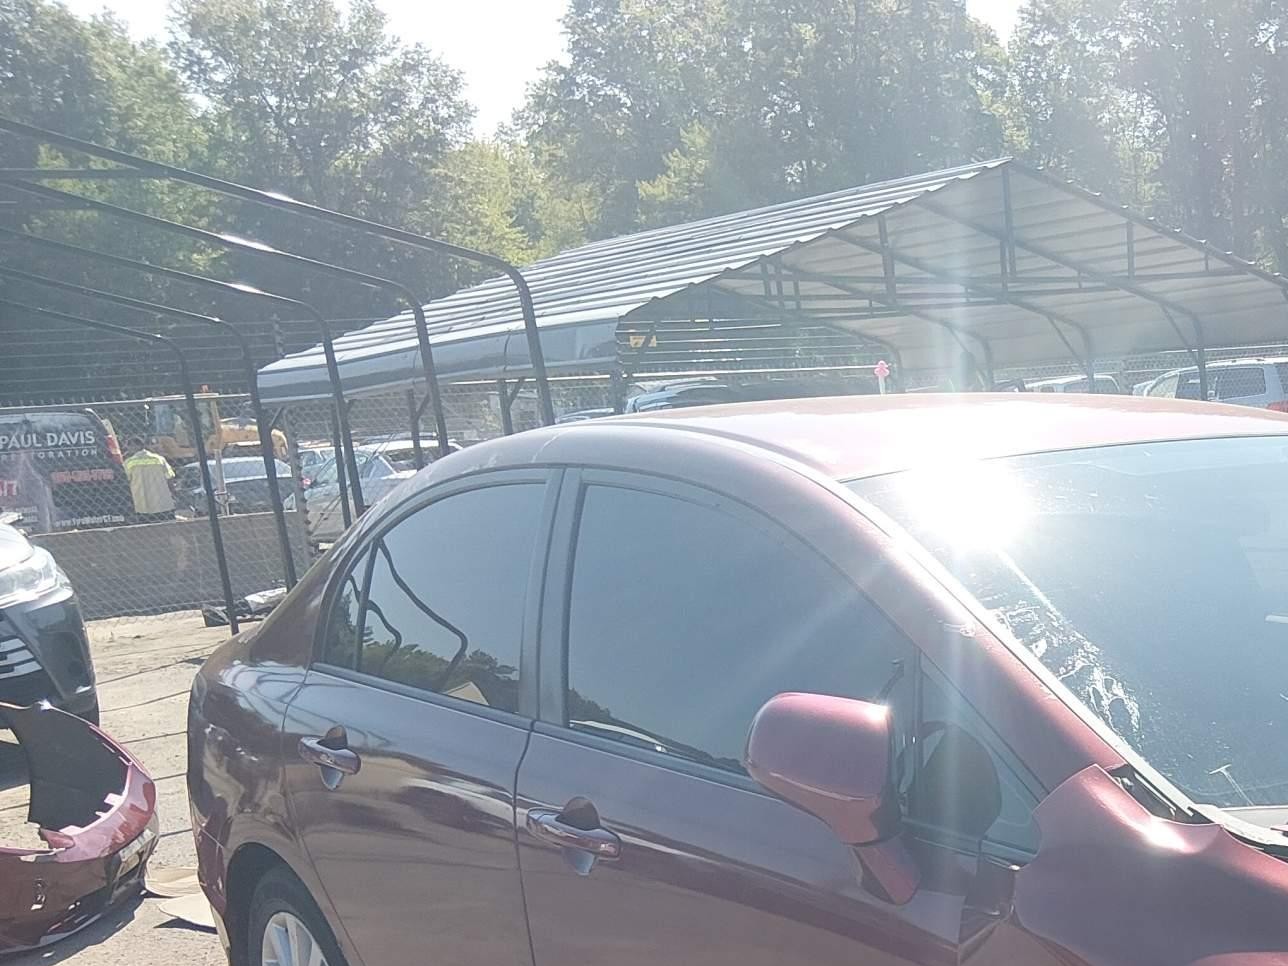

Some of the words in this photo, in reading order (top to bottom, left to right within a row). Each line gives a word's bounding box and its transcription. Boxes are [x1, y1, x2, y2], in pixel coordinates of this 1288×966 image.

[0, 433, 42, 449] PAUL
[46, 430, 95, 446] DAVIS
[1, 449, 97, 460] REORATION
